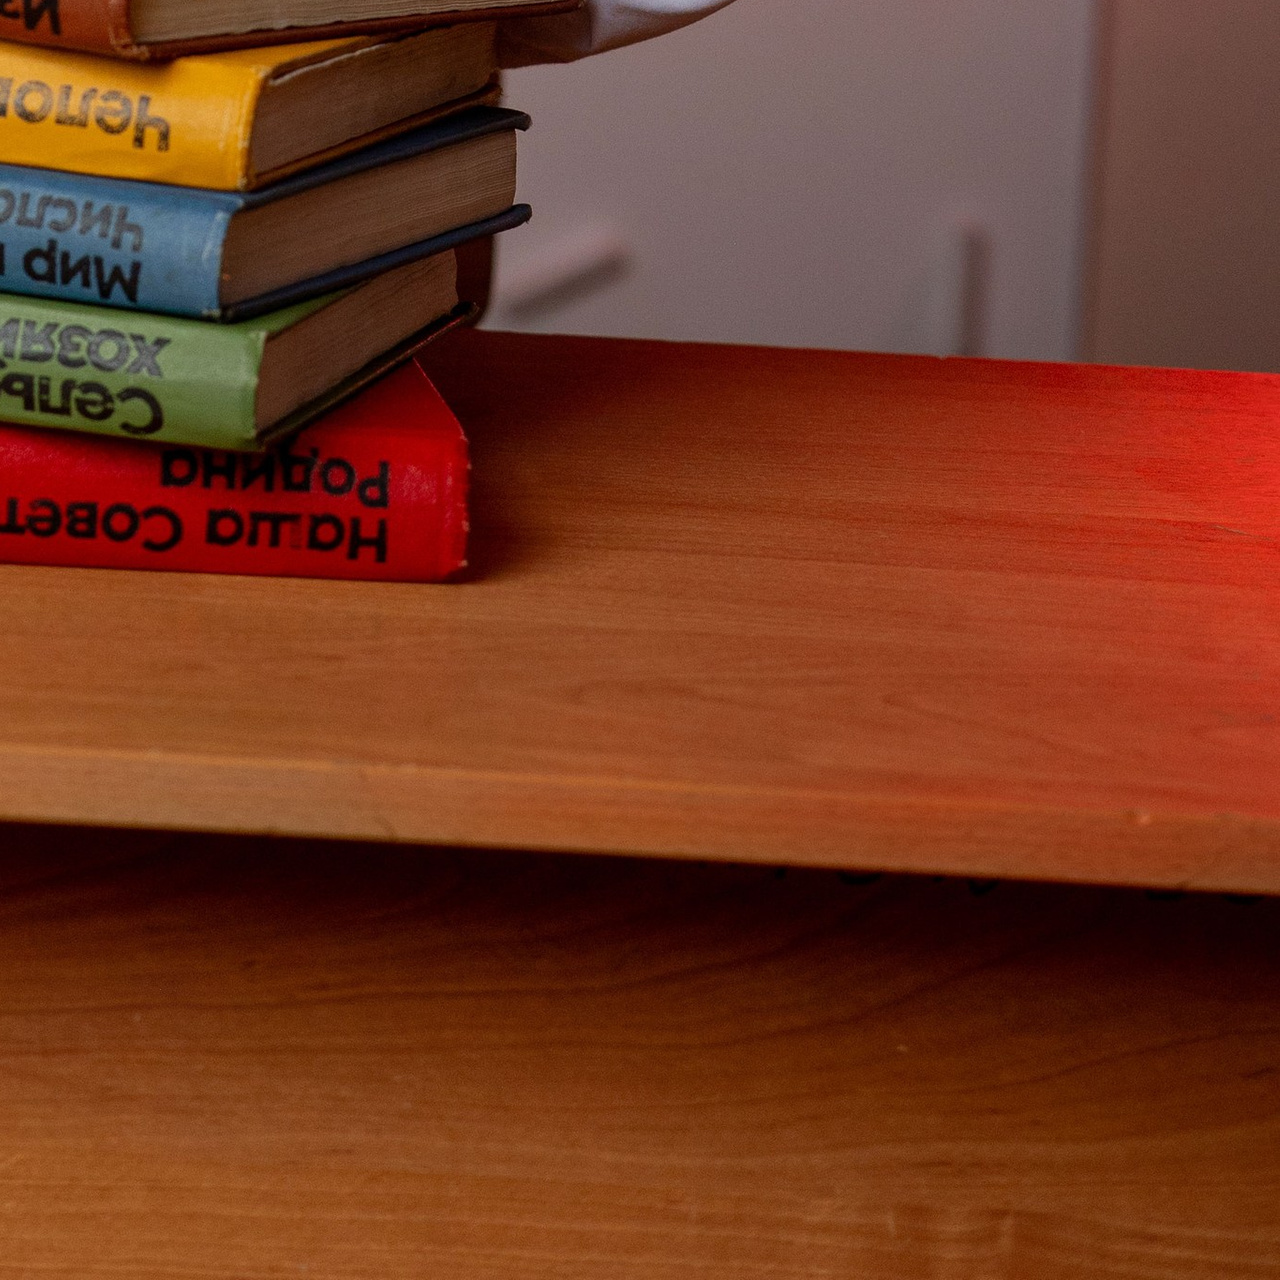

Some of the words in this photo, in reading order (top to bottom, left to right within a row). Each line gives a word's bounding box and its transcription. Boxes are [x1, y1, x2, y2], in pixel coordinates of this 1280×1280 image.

[24, 241, 141, 304] Мир
[160, 448, 390, 509] Родина
[205, 506, 388, 564] Наша
